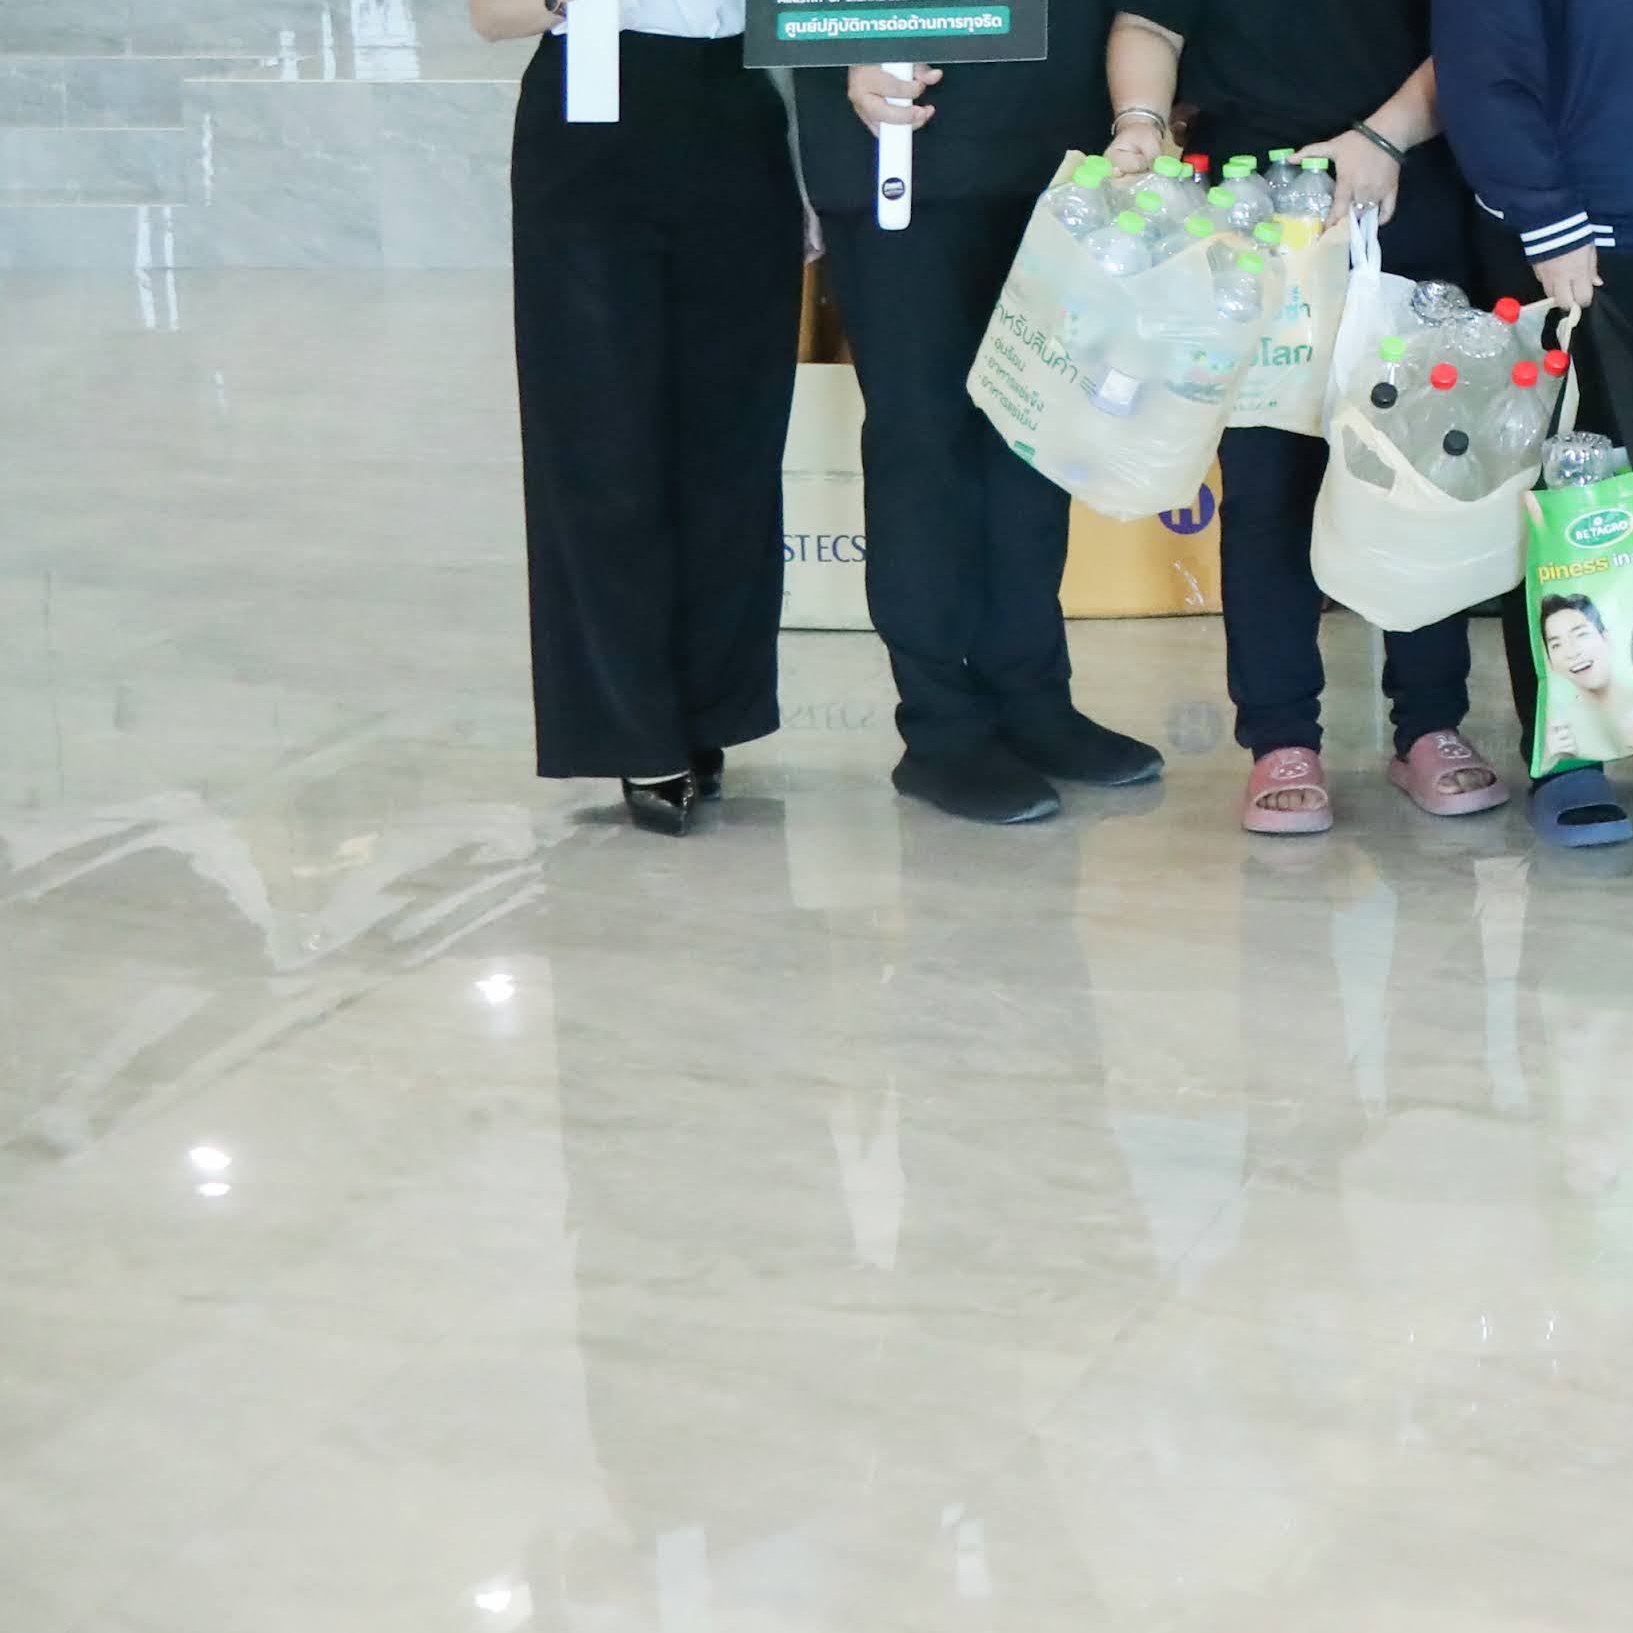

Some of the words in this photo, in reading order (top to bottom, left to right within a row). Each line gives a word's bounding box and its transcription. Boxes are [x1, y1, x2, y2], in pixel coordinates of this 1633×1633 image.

[785, 13, 1003, 39] ศูนย์ปฏิบัติการต่อต้านการทุจริต
[1575, 520, 1629, 542] BETAGRO
[1536, 554, 1610, 585] piness
[1612, 551, 1632, 568] in
